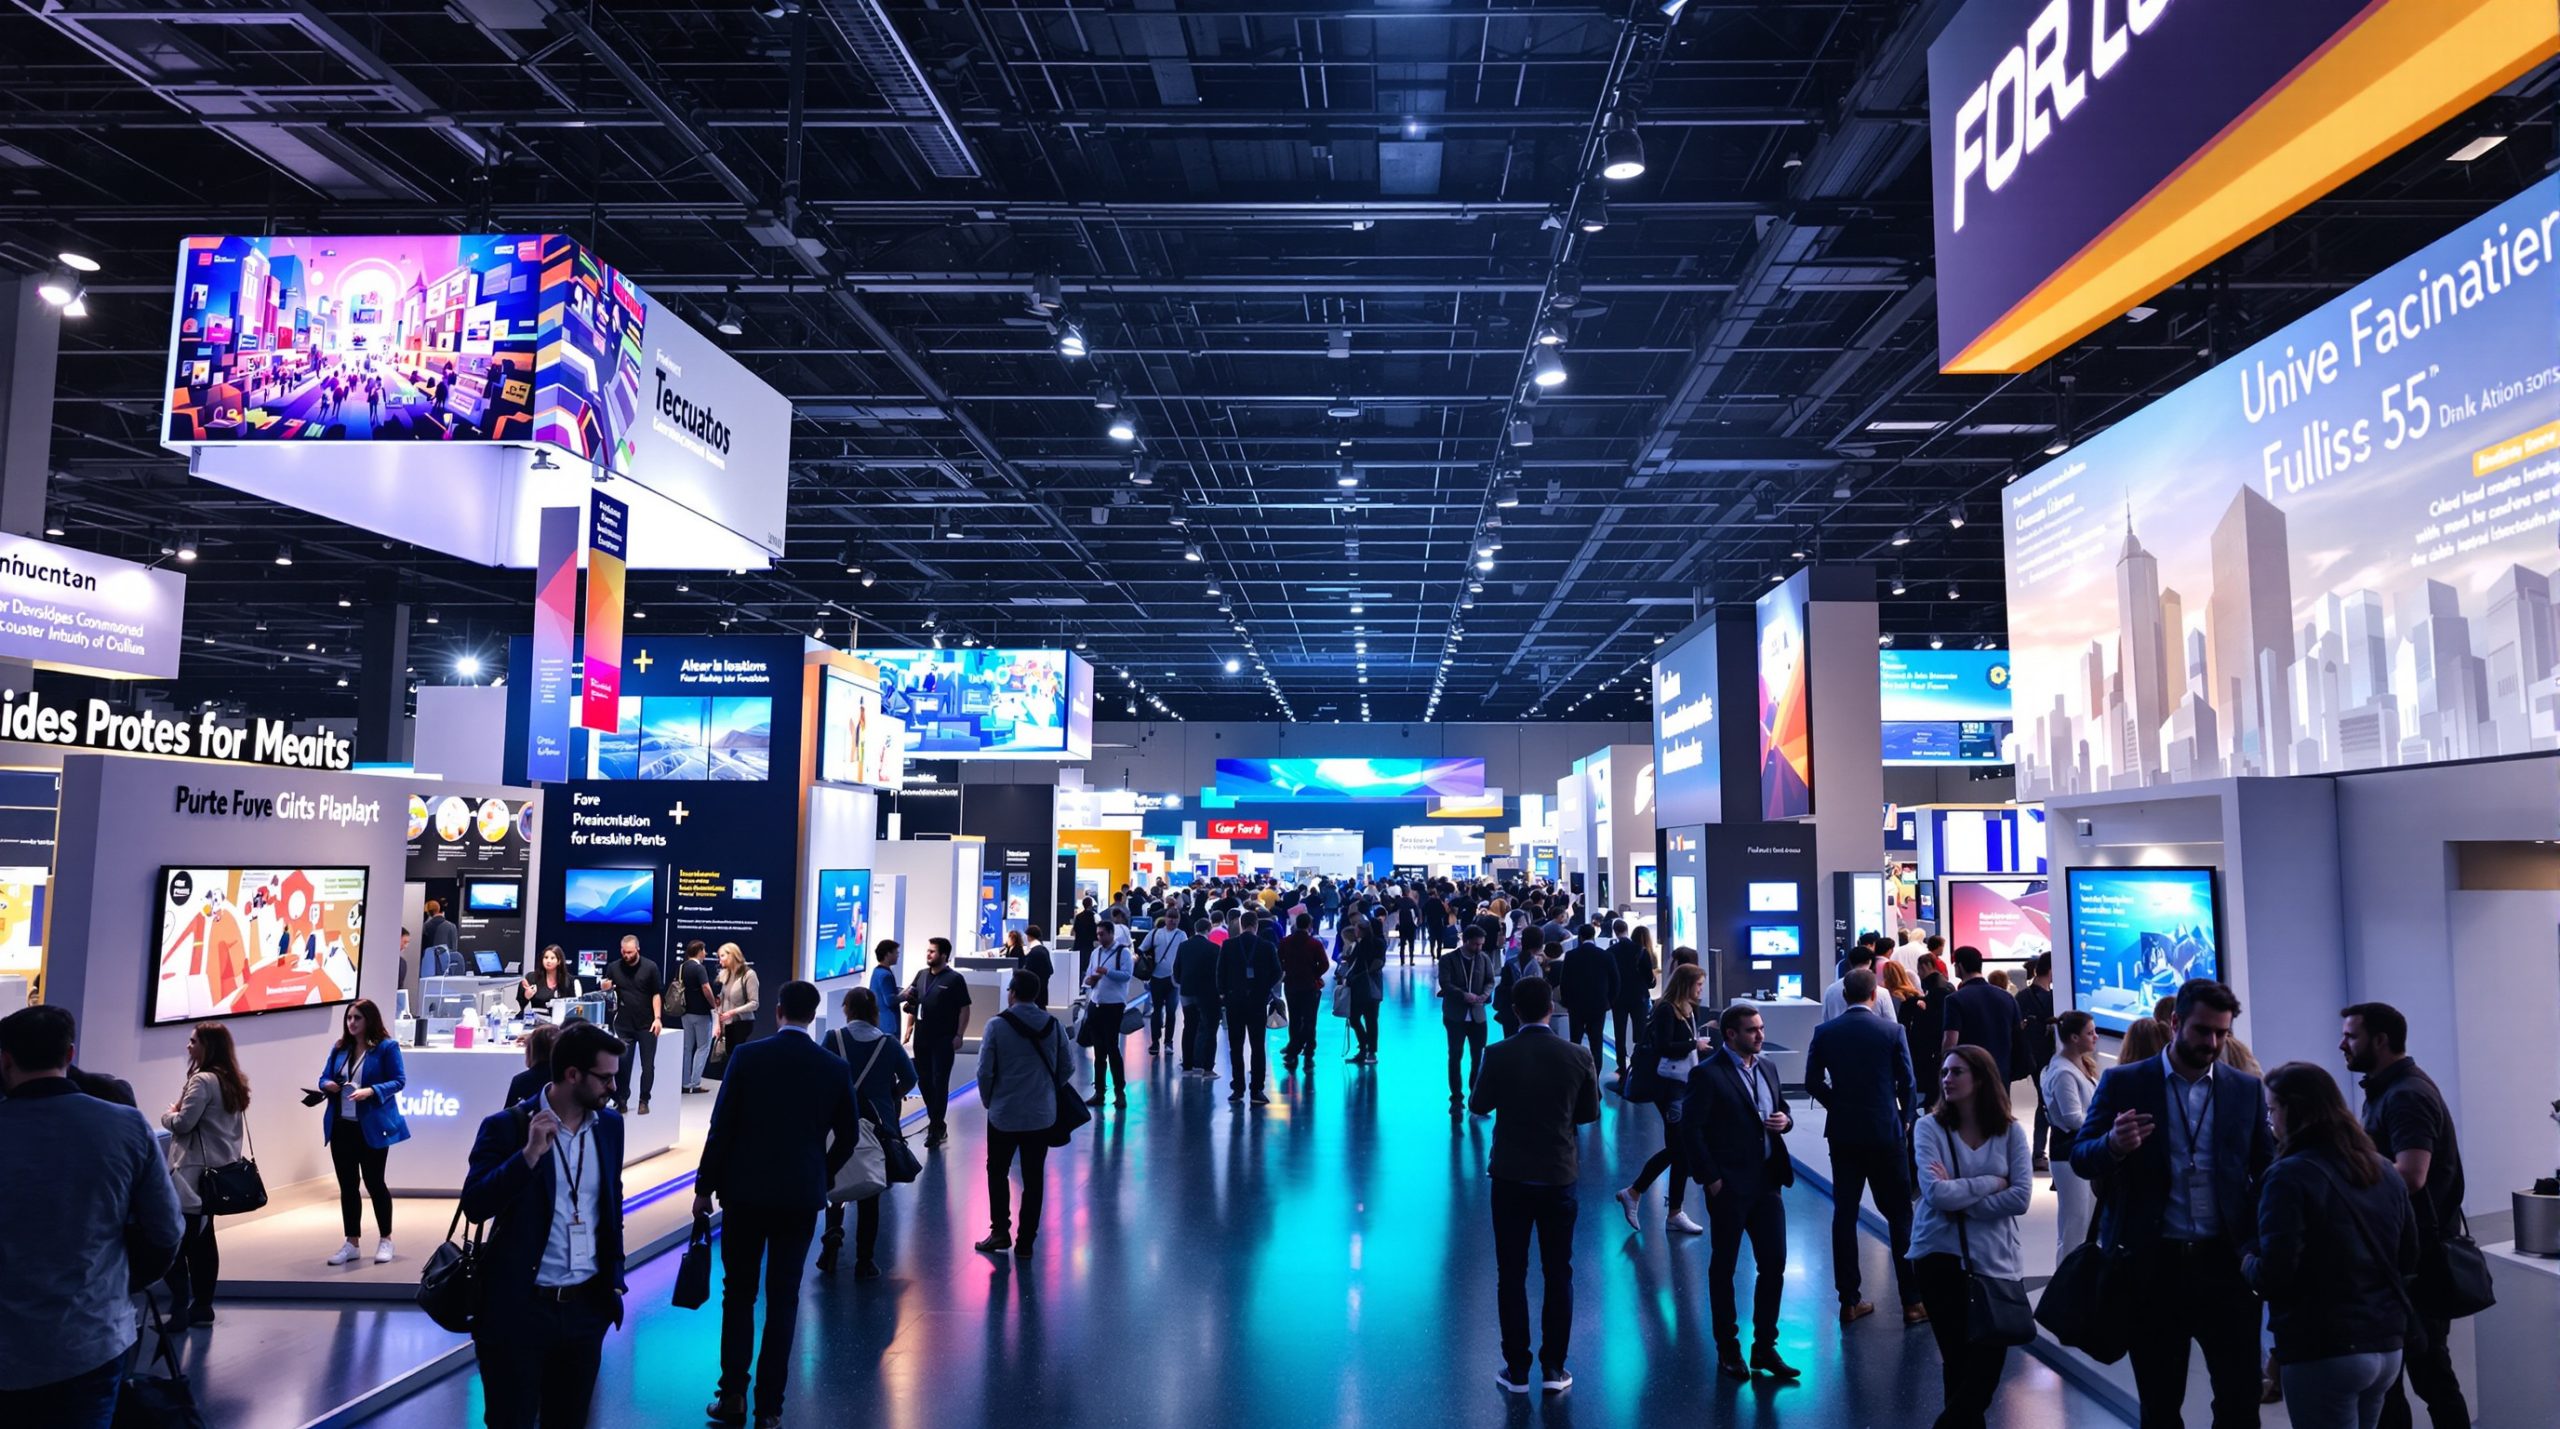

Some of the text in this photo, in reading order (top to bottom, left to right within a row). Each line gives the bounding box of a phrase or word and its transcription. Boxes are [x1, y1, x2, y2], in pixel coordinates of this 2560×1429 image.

[2240, 340, 2340, 424] Unive
[1, 688, 78, 744] ides
[86, 698, 191, 755] Protes
[199, 711, 247, 760] for
